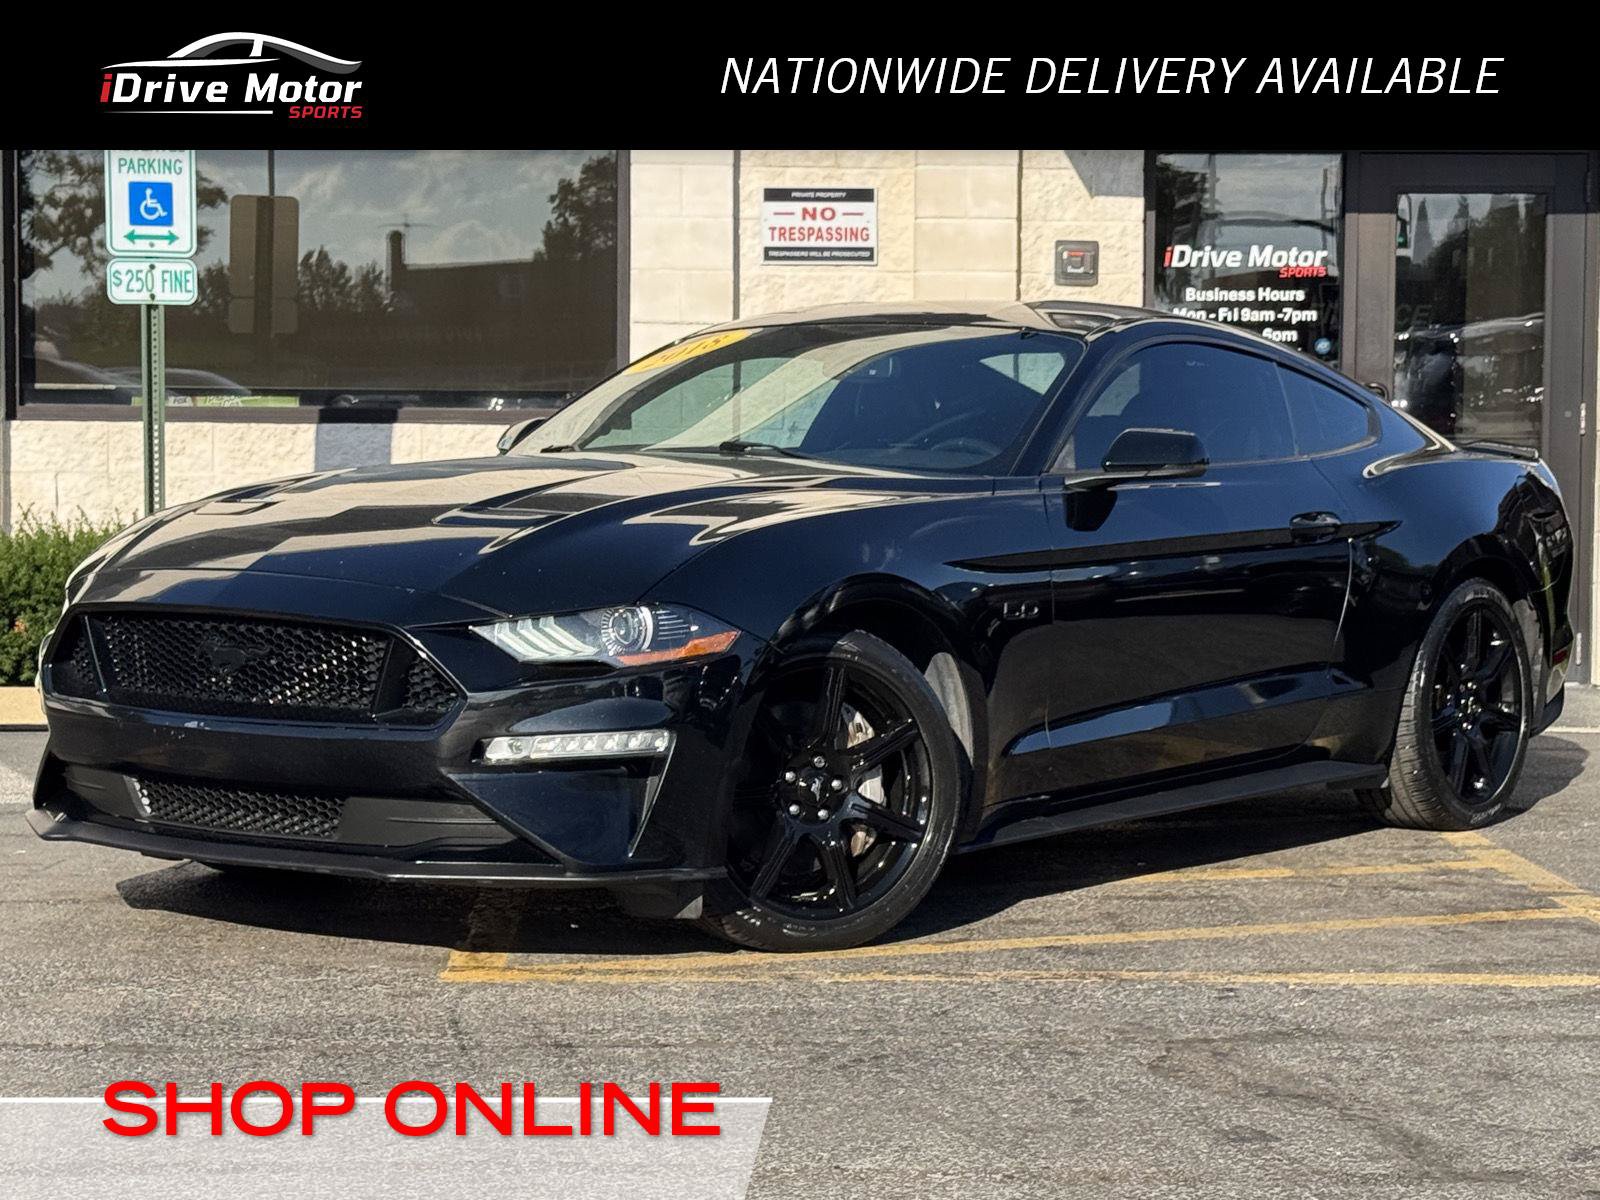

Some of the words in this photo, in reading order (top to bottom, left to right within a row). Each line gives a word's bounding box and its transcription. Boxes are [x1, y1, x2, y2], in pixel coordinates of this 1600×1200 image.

[118, 158, 183, 175] PARKING
[801, 207, 836, 221] NO
[768, 226, 870, 242] TRESPASSING
[1163, 244, 1243, 268] iDrive
[1248, 244, 1328, 268] Motor
[1279, 265, 1327, 279] SPORTS
[112, 269, 155, 293] $250
[161, 269, 193, 294] FINE
[1185, 286, 1256, 302] Business
[1257, 286, 1306, 302] Hours
[1240, 307, 1276, 322] 9am
